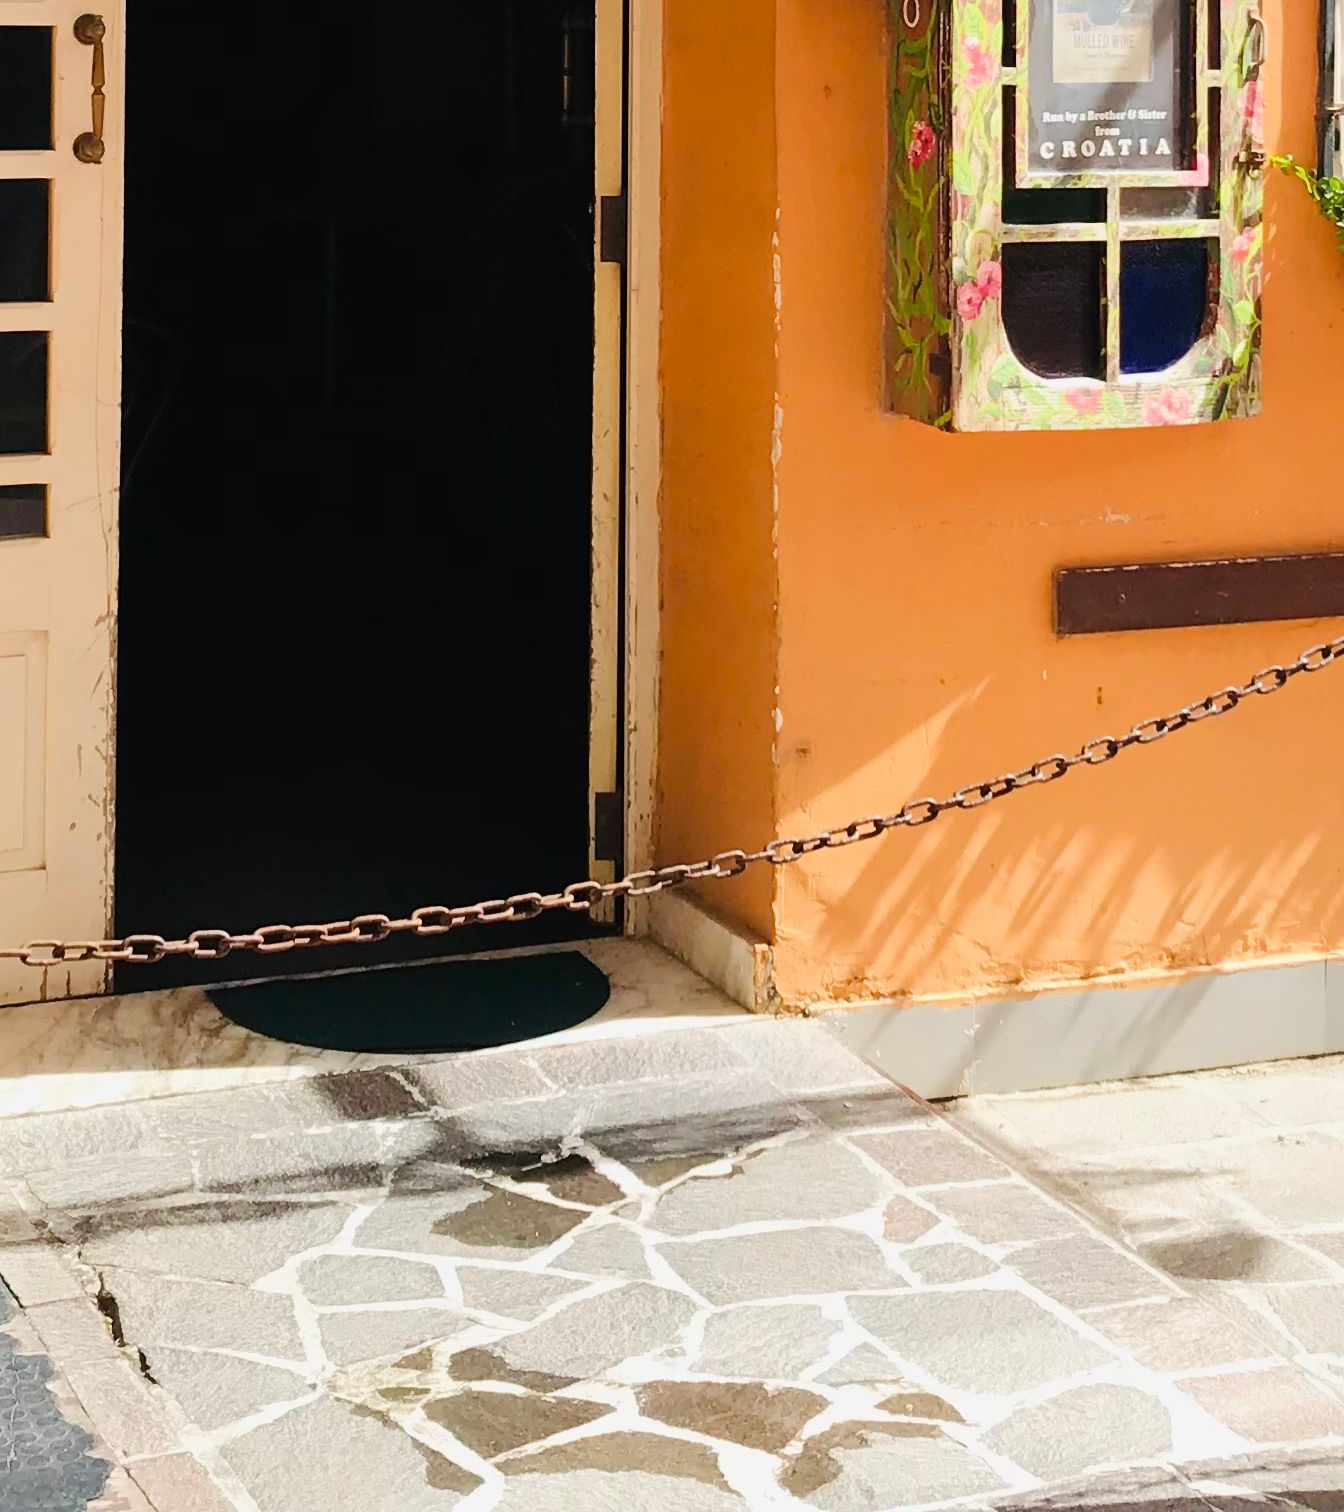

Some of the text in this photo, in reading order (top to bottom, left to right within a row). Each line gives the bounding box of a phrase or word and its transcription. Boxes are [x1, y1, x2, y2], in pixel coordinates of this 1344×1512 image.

[1042, 109, 1167, 124] Run by a Brother & Sister
[1095, 125, 1120, 136] from
[1040, 138, 1171, 159] CROATIA
